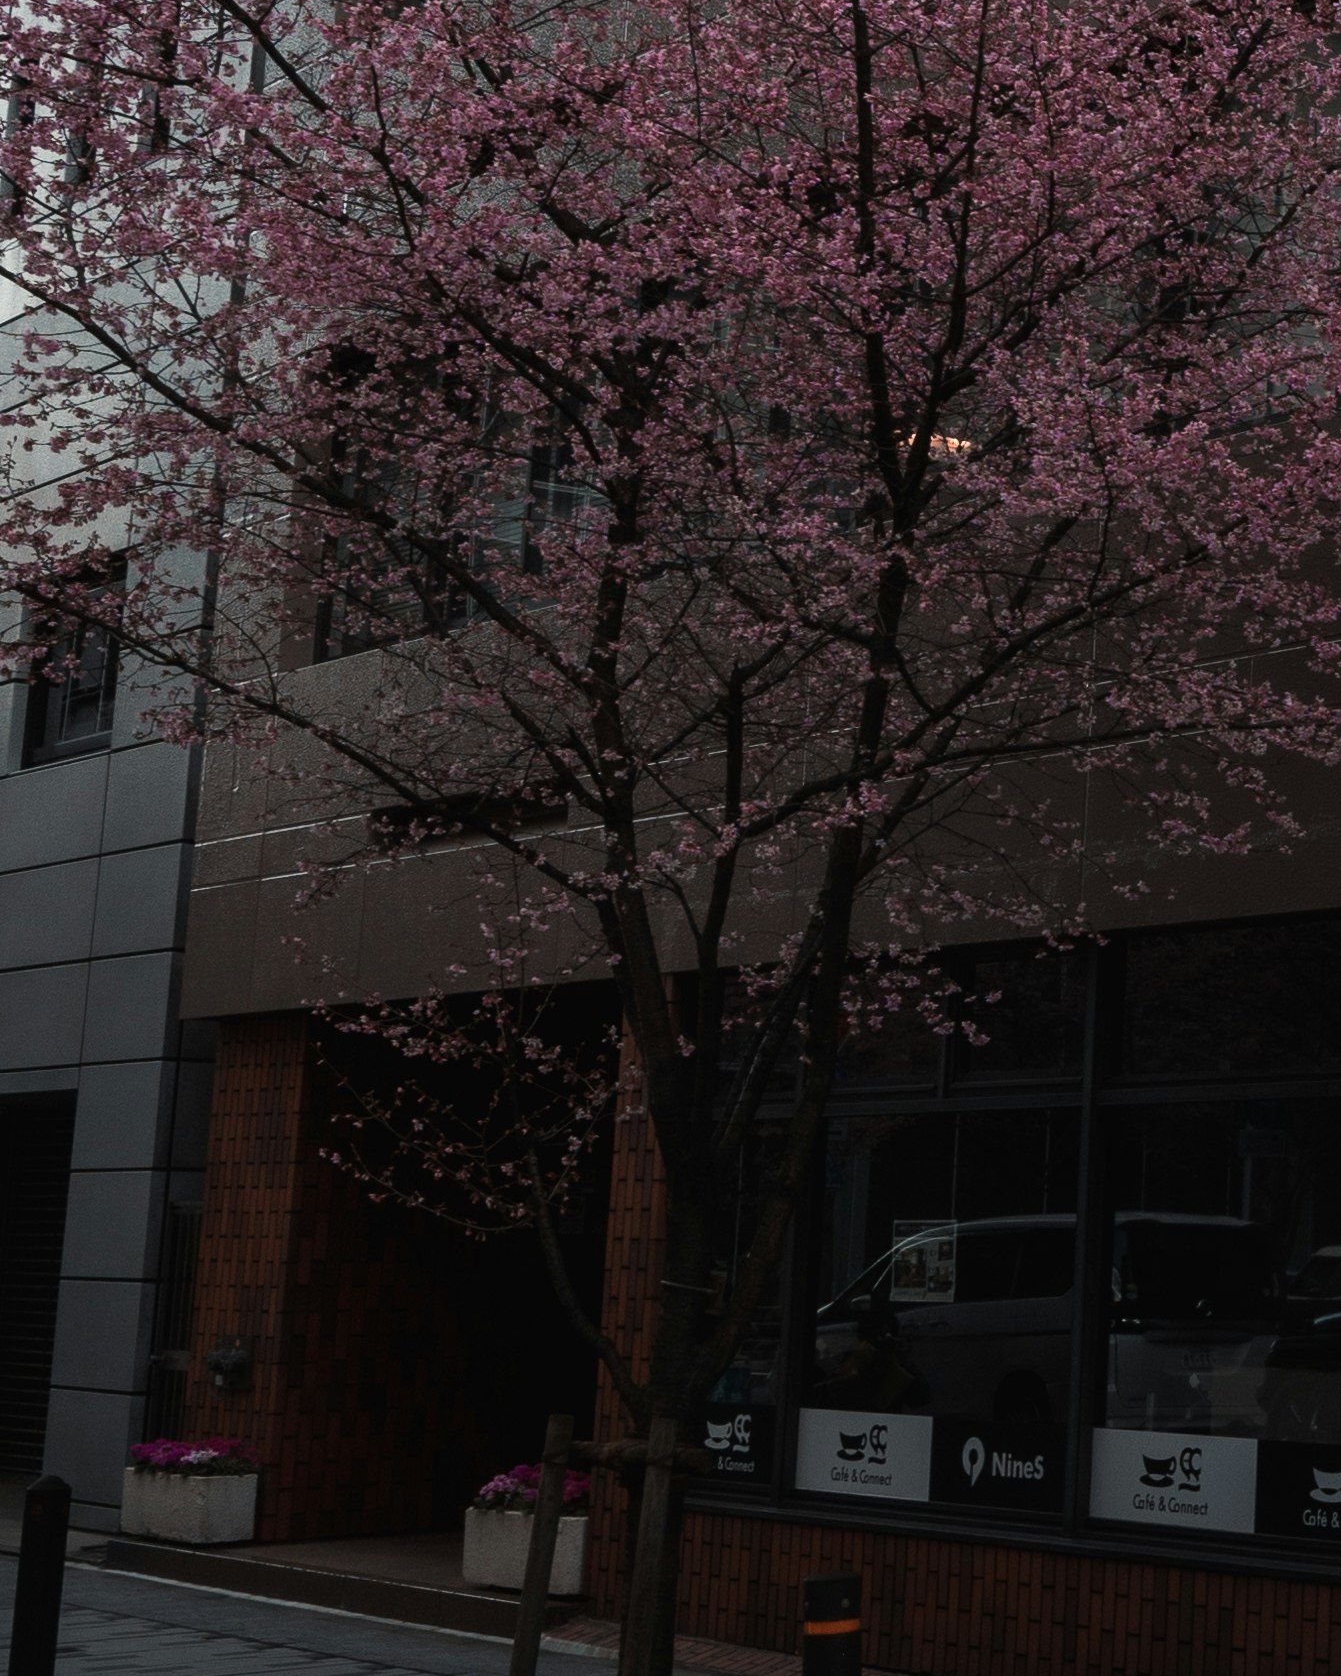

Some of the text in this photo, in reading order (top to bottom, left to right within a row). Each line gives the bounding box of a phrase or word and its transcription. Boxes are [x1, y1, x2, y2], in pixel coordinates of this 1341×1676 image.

[725, 1456, 755, 1473] Connect
[991, 1451, 1044, 1480] NineS
[830, 1466, 892, 1486] Café & Connect
[1132, 1493, 1208, 1515] Café & Connect
[1302, 1508, 1328, 1528] Café
[1331, 1511, 1340, 1528] &
